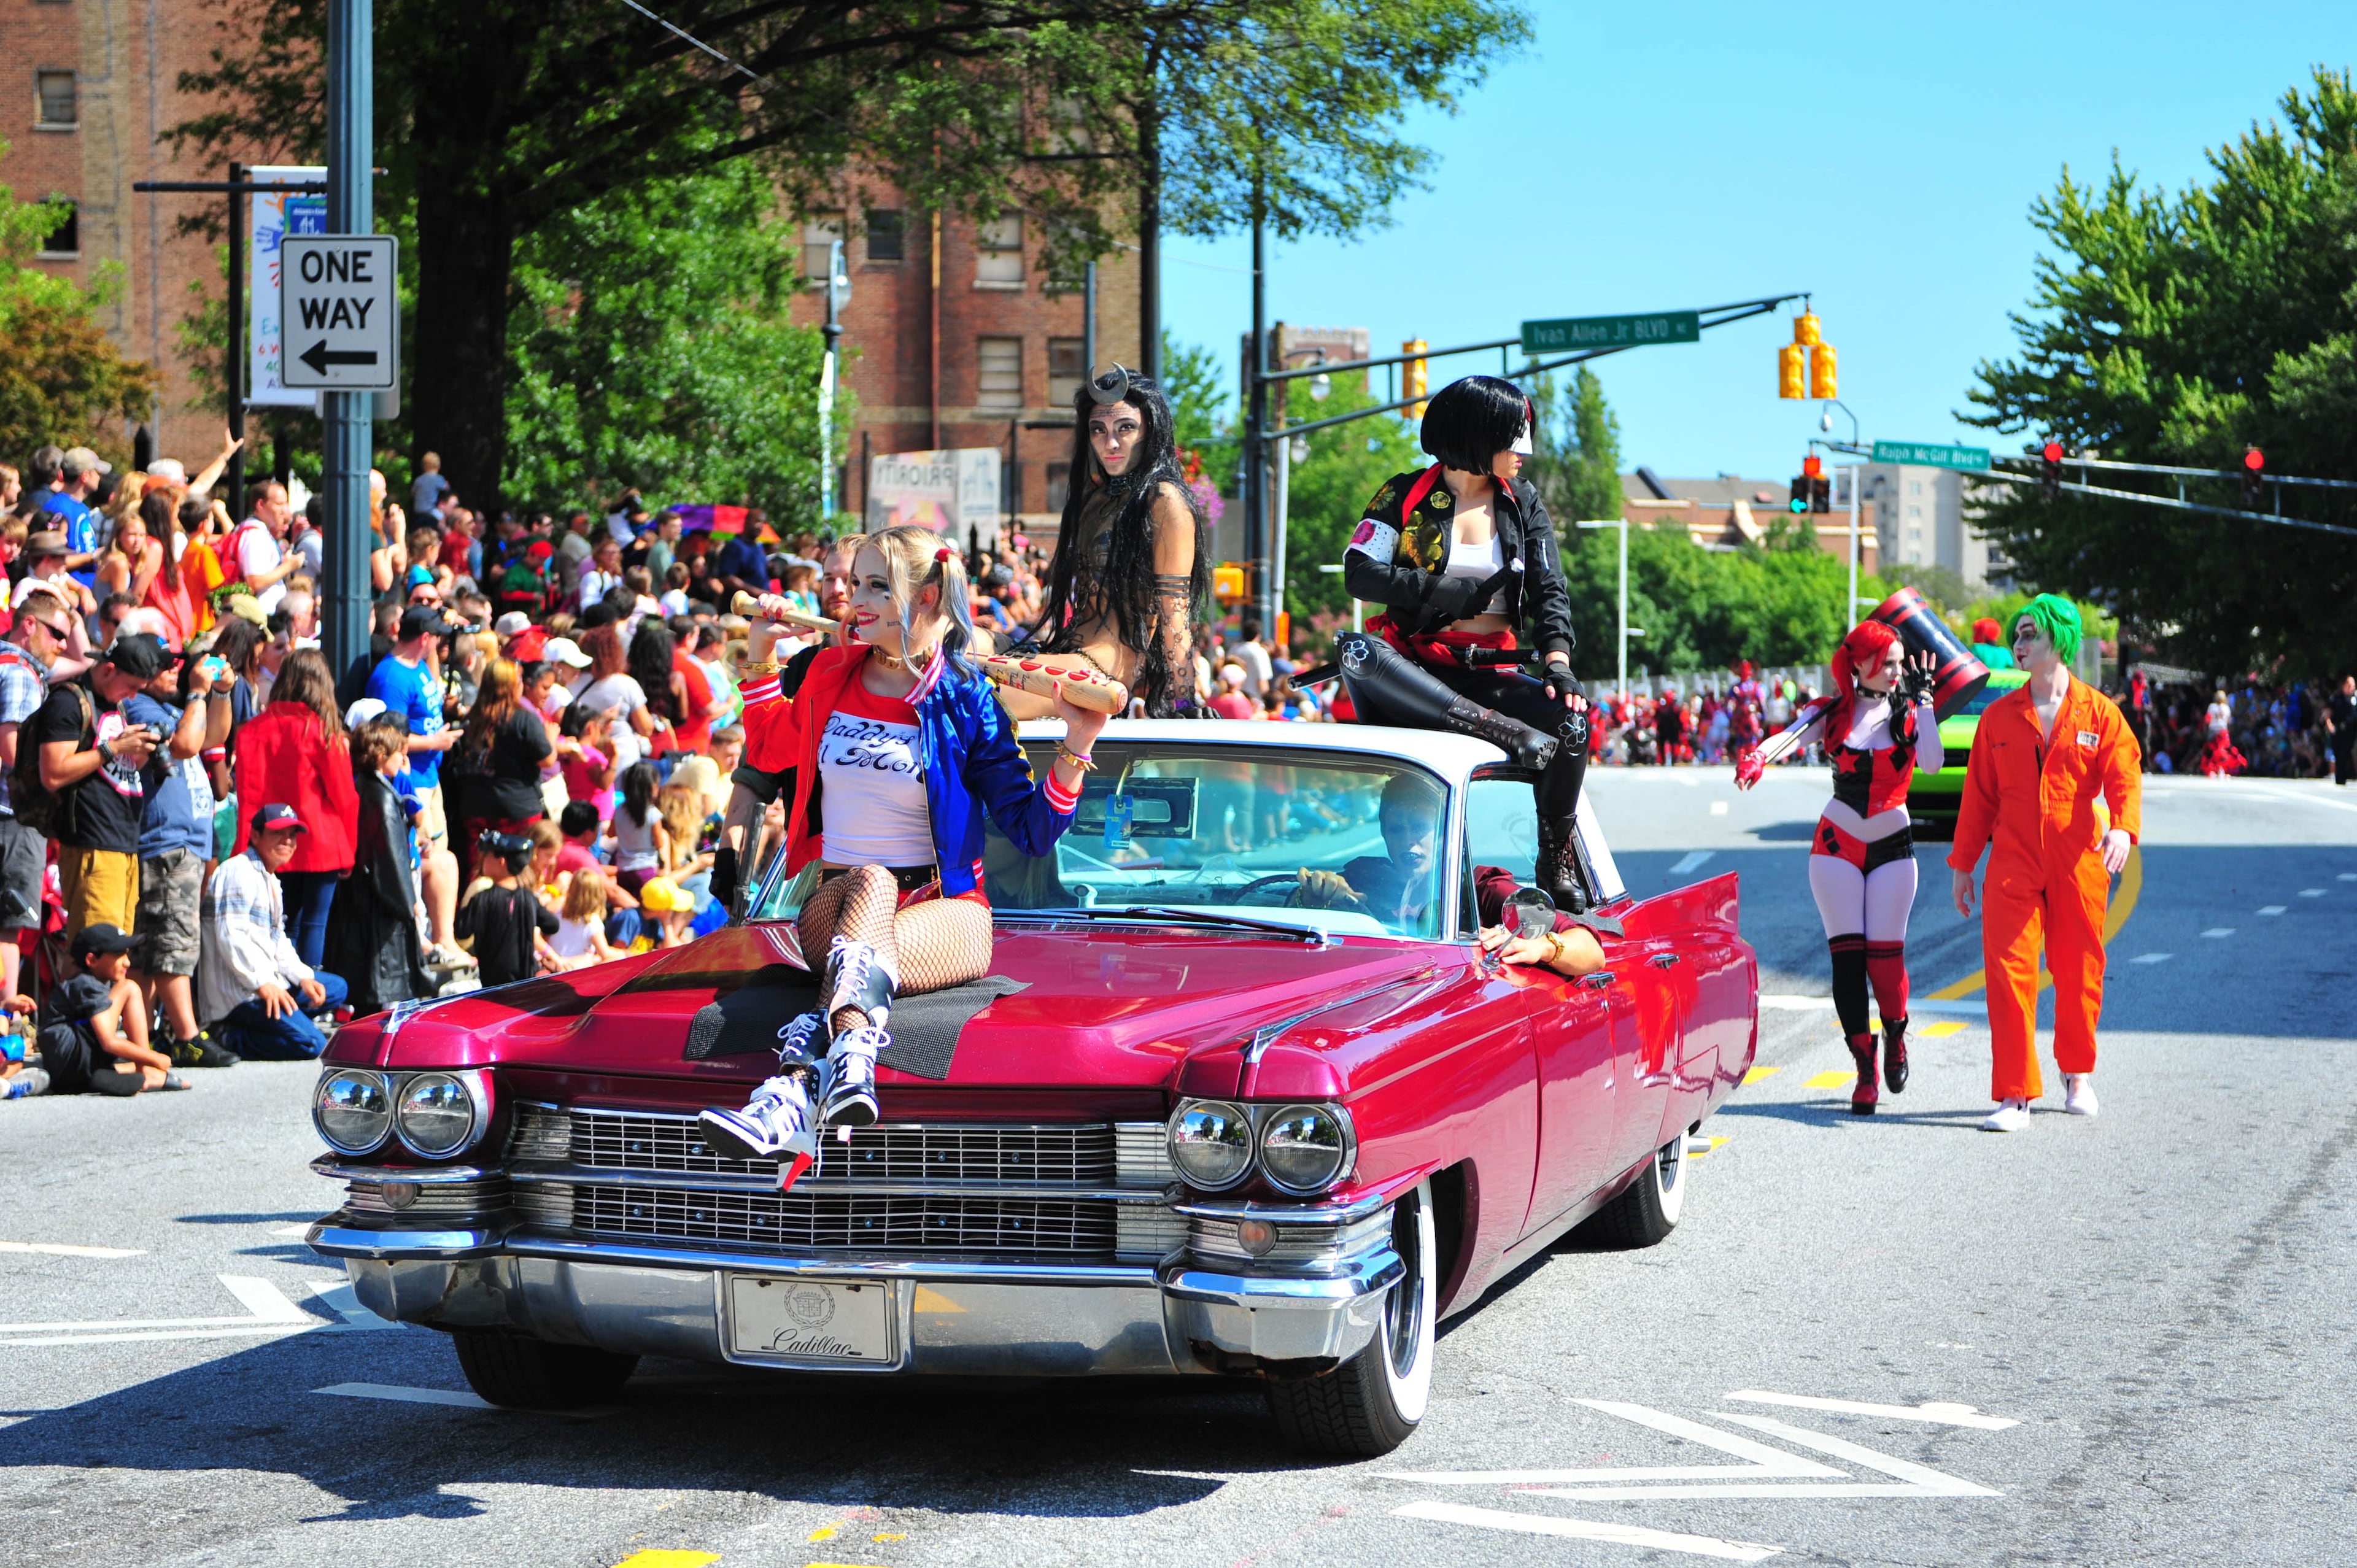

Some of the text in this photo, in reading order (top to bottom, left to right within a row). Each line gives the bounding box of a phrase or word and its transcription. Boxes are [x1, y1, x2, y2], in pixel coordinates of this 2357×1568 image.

[301, 250, 373, 283] ONE
[300, 298, 375, 330] WAY
[1533, 325, 1564, 344] Ivan
[1570, 322, 1608, 342] Allen
[1613, 322, 1629, 340] Jr
[1634, 319, 1669, 338] BLVD
[1878, 444, 1909, 462] Ralph
[1914, 446, 1947, 462] McGill
[1952, 450, 1973, 465] Blvd
[824, 716, 915, 748] Daddy's
[773, 1327, 851, 1356] Cadillac
